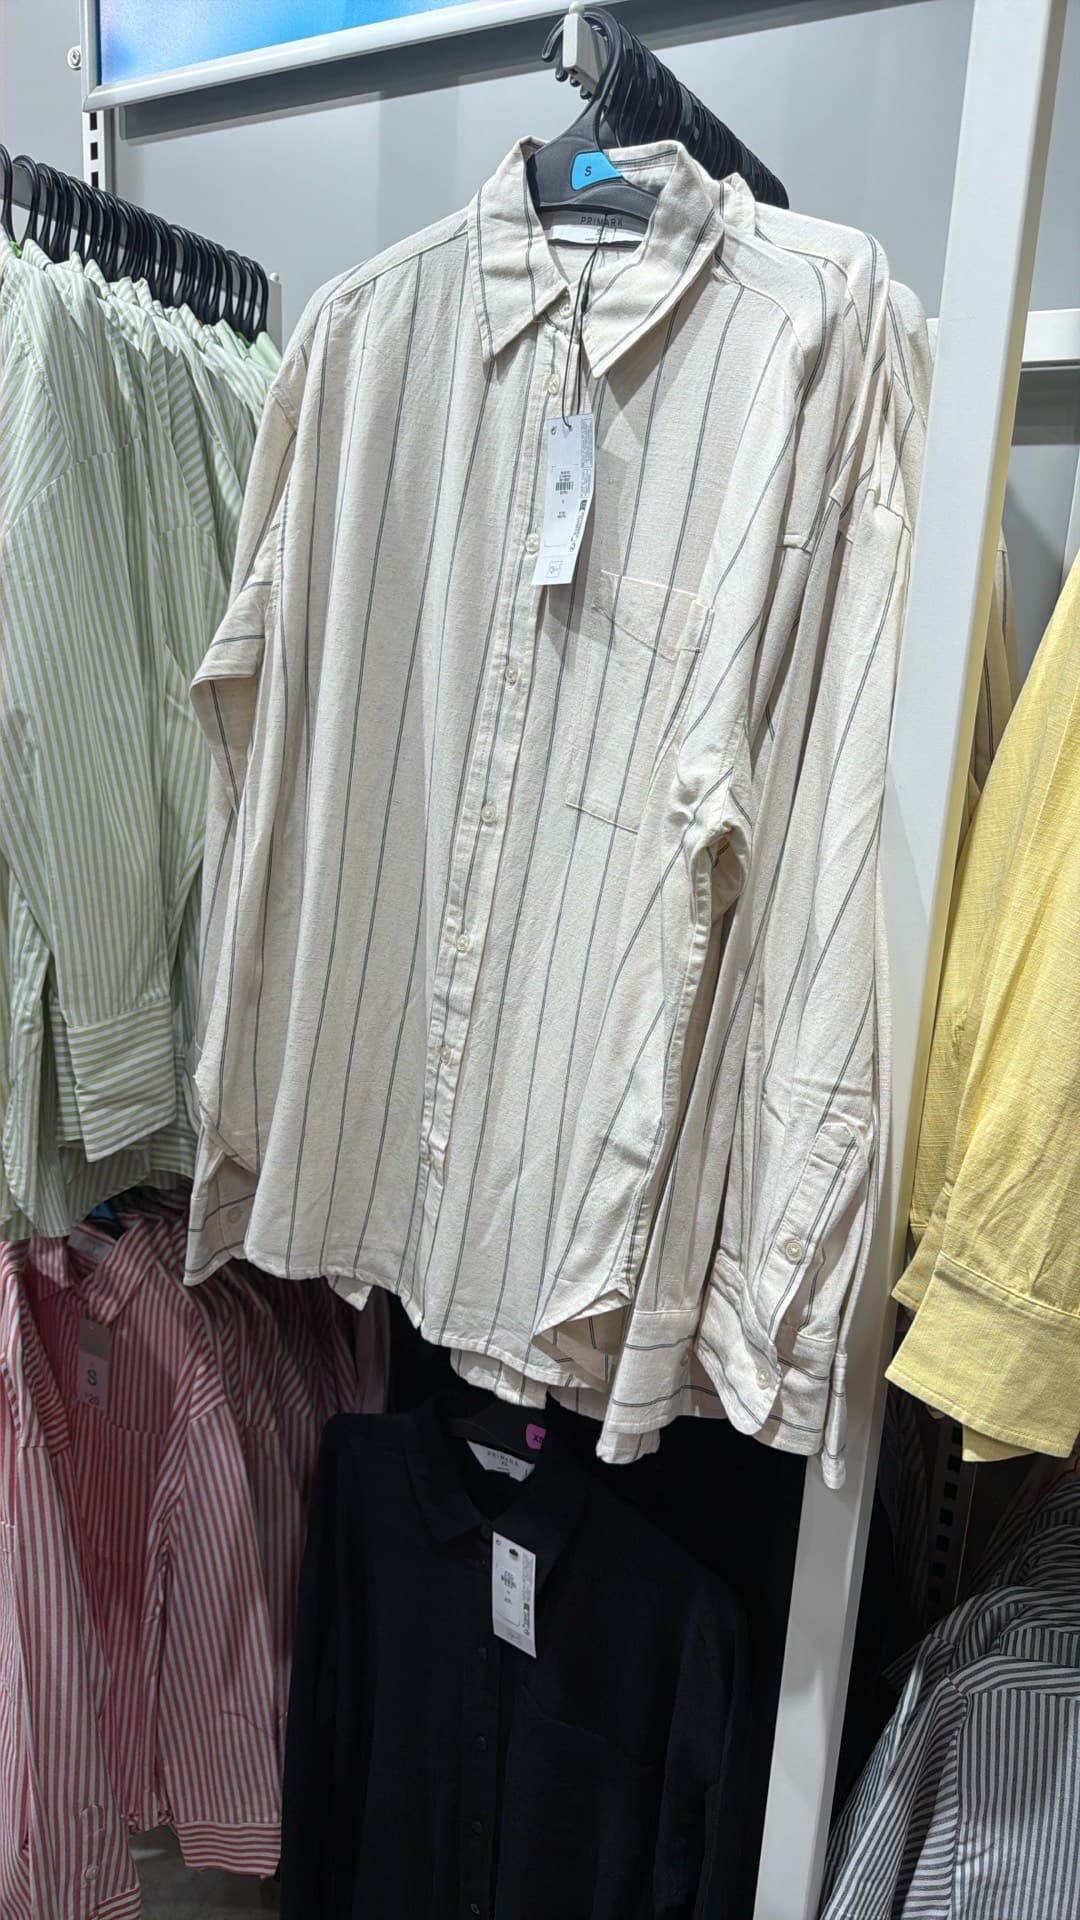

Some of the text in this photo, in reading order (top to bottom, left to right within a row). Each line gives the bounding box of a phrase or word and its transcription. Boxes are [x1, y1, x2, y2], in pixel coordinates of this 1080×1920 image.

[585, 166, 592, 177] S
[579, 216, 624, 227] PRIMARK
[88, 1369, 97, 1386] S
